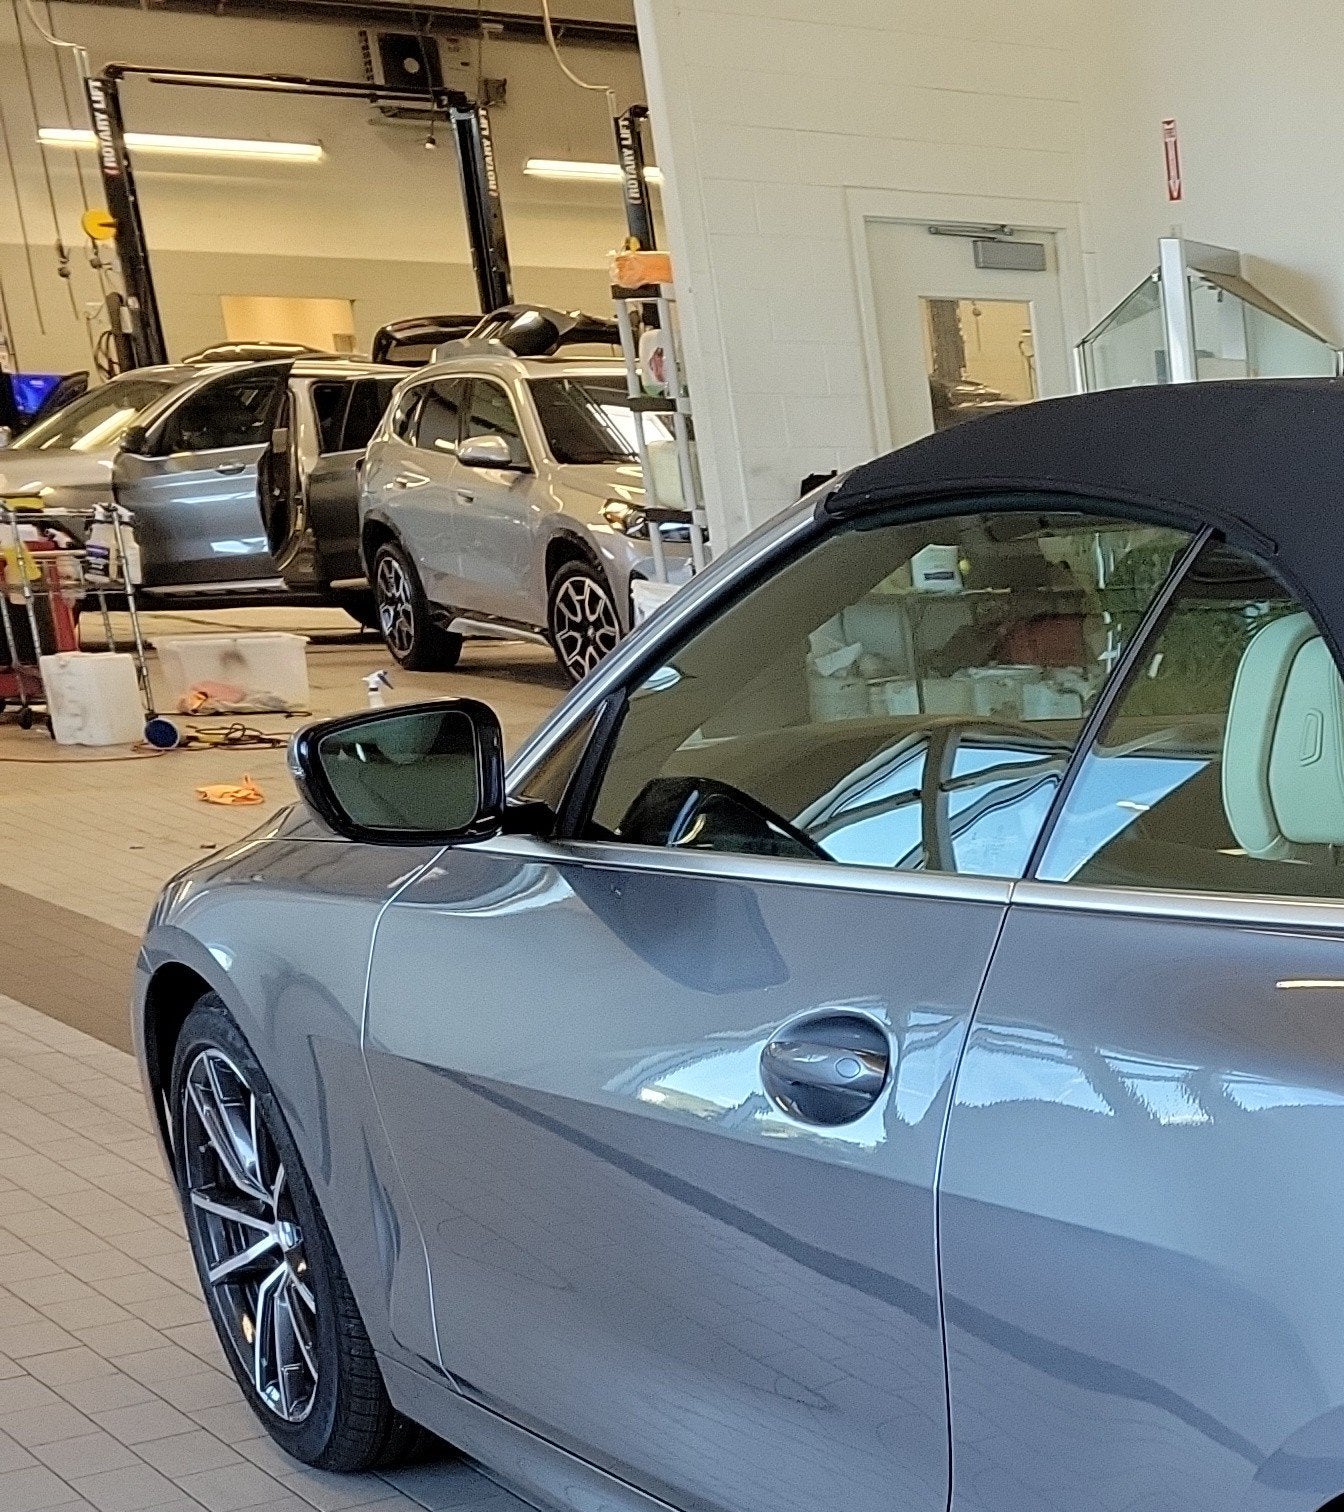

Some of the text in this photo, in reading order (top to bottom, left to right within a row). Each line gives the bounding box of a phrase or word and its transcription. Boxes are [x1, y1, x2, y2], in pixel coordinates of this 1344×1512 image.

[88, 80, 118, 168] ROTARY LIFT
[618, 119, 641, 198] ROTARY LIFT
